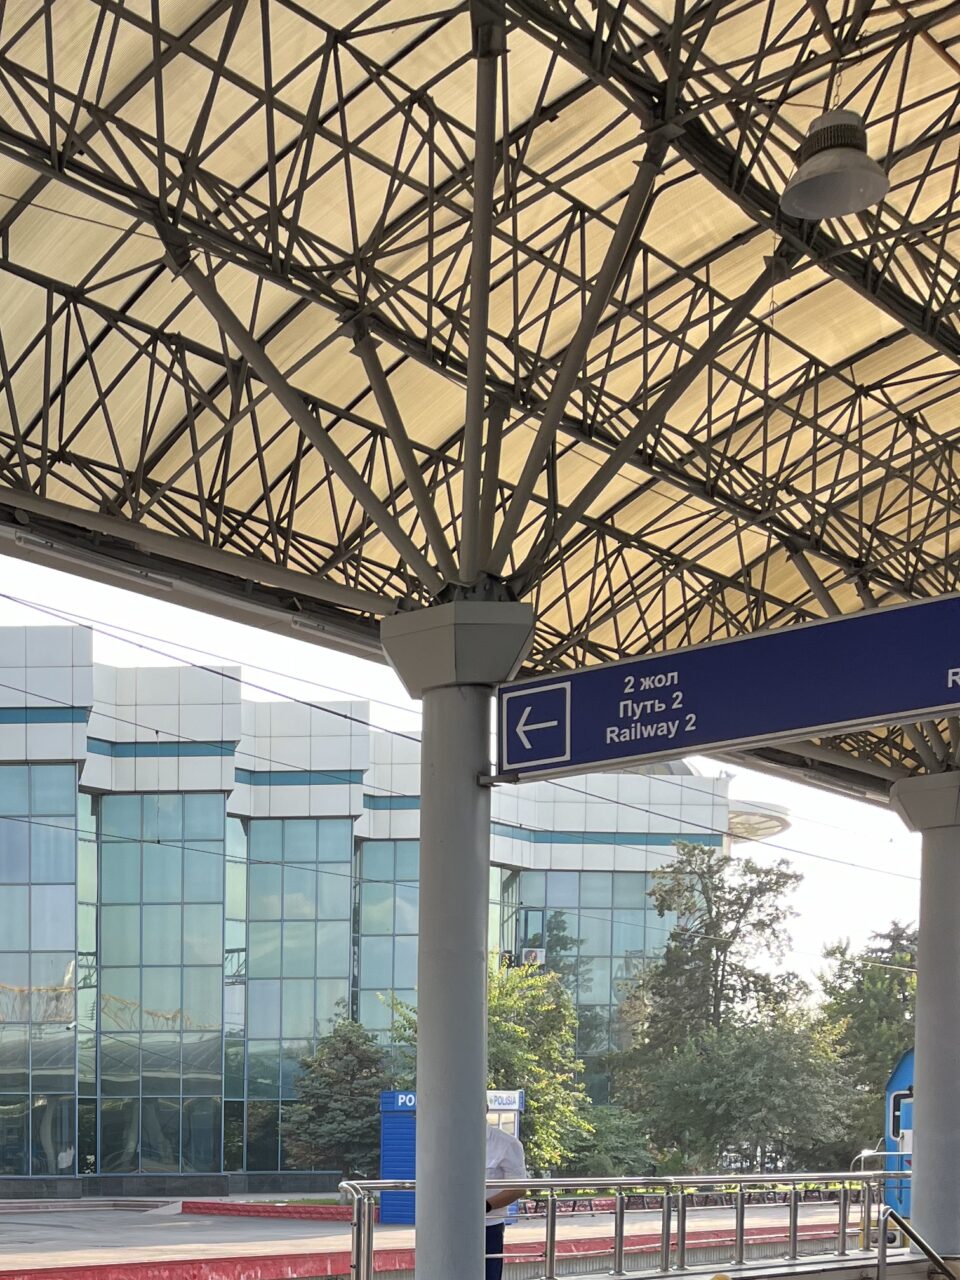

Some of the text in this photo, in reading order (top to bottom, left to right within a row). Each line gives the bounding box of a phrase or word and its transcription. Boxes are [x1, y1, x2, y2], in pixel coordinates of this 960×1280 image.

[623, 671, 679, 693] 2 жол
[619, 691, 683, 720] Путь 2
[606, 713, 697, 744] Railway 2
[398, 1094, 418, 1106] PO
